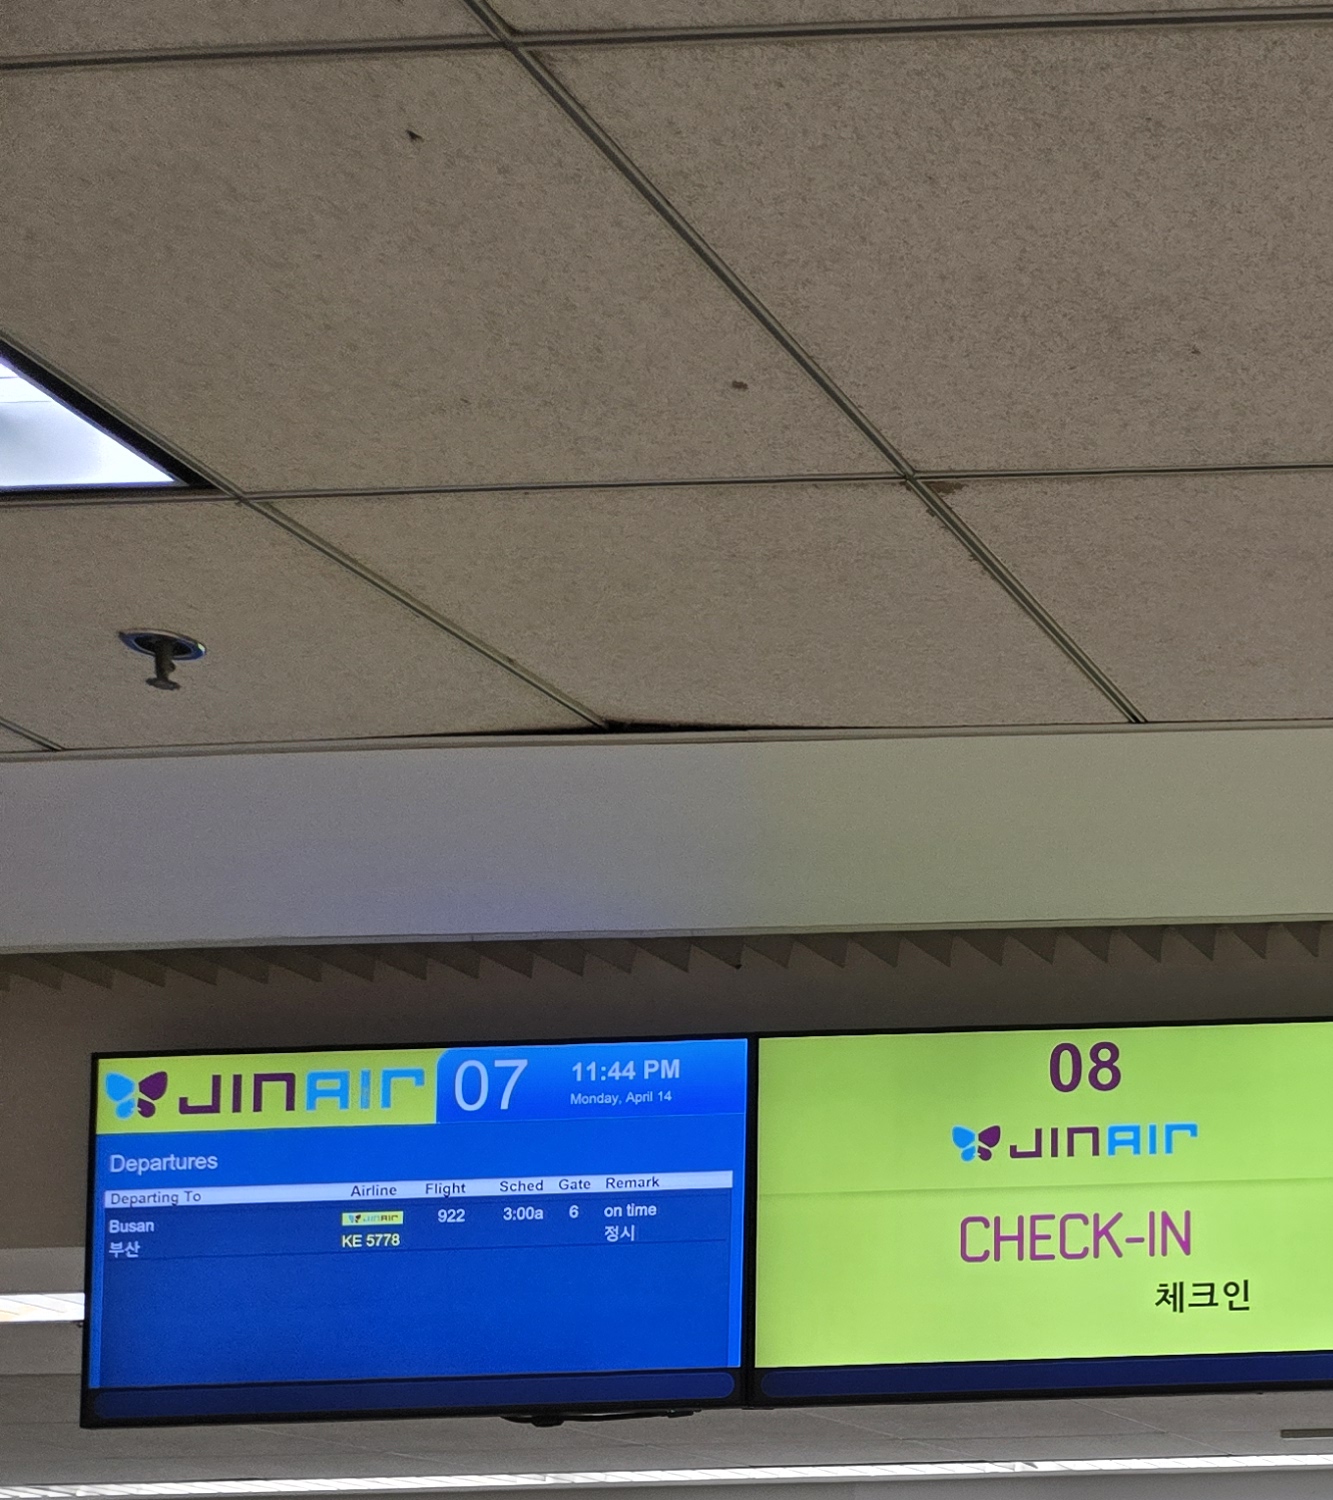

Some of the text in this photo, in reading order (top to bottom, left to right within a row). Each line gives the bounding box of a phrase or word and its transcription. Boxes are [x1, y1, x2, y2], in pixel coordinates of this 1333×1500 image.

[571, 1059, 681, 1083] 11:44 PM
[1049, 1042, 1122, 1092] 08
[453, 1059, 529, 1112] 07
[570, 1090, 672, 1107] Monday, April 14
[109, 1153, 218, 1176] Departures
[110, 1175, 660, 1207] Departing To Airline Flight Sched Gate Remark
[437, 1208, 465, 1223] 922
[503, 1205, 544, 1221] 3:00a
[569, 1205, 579, 1219] 6
[604, 1201, 657, 1218] on time
[109, 1218, 155, 1234] Busan
[605, 1224, 635, 1241] 정시
[342, 1233, 400, 1248] KE 5778
[959, 1210, 1192, 1263] CHECK-IN
[109, 1240, 140, 1258] 부산
[1155, 1279, 1251, 1313] 체크인
